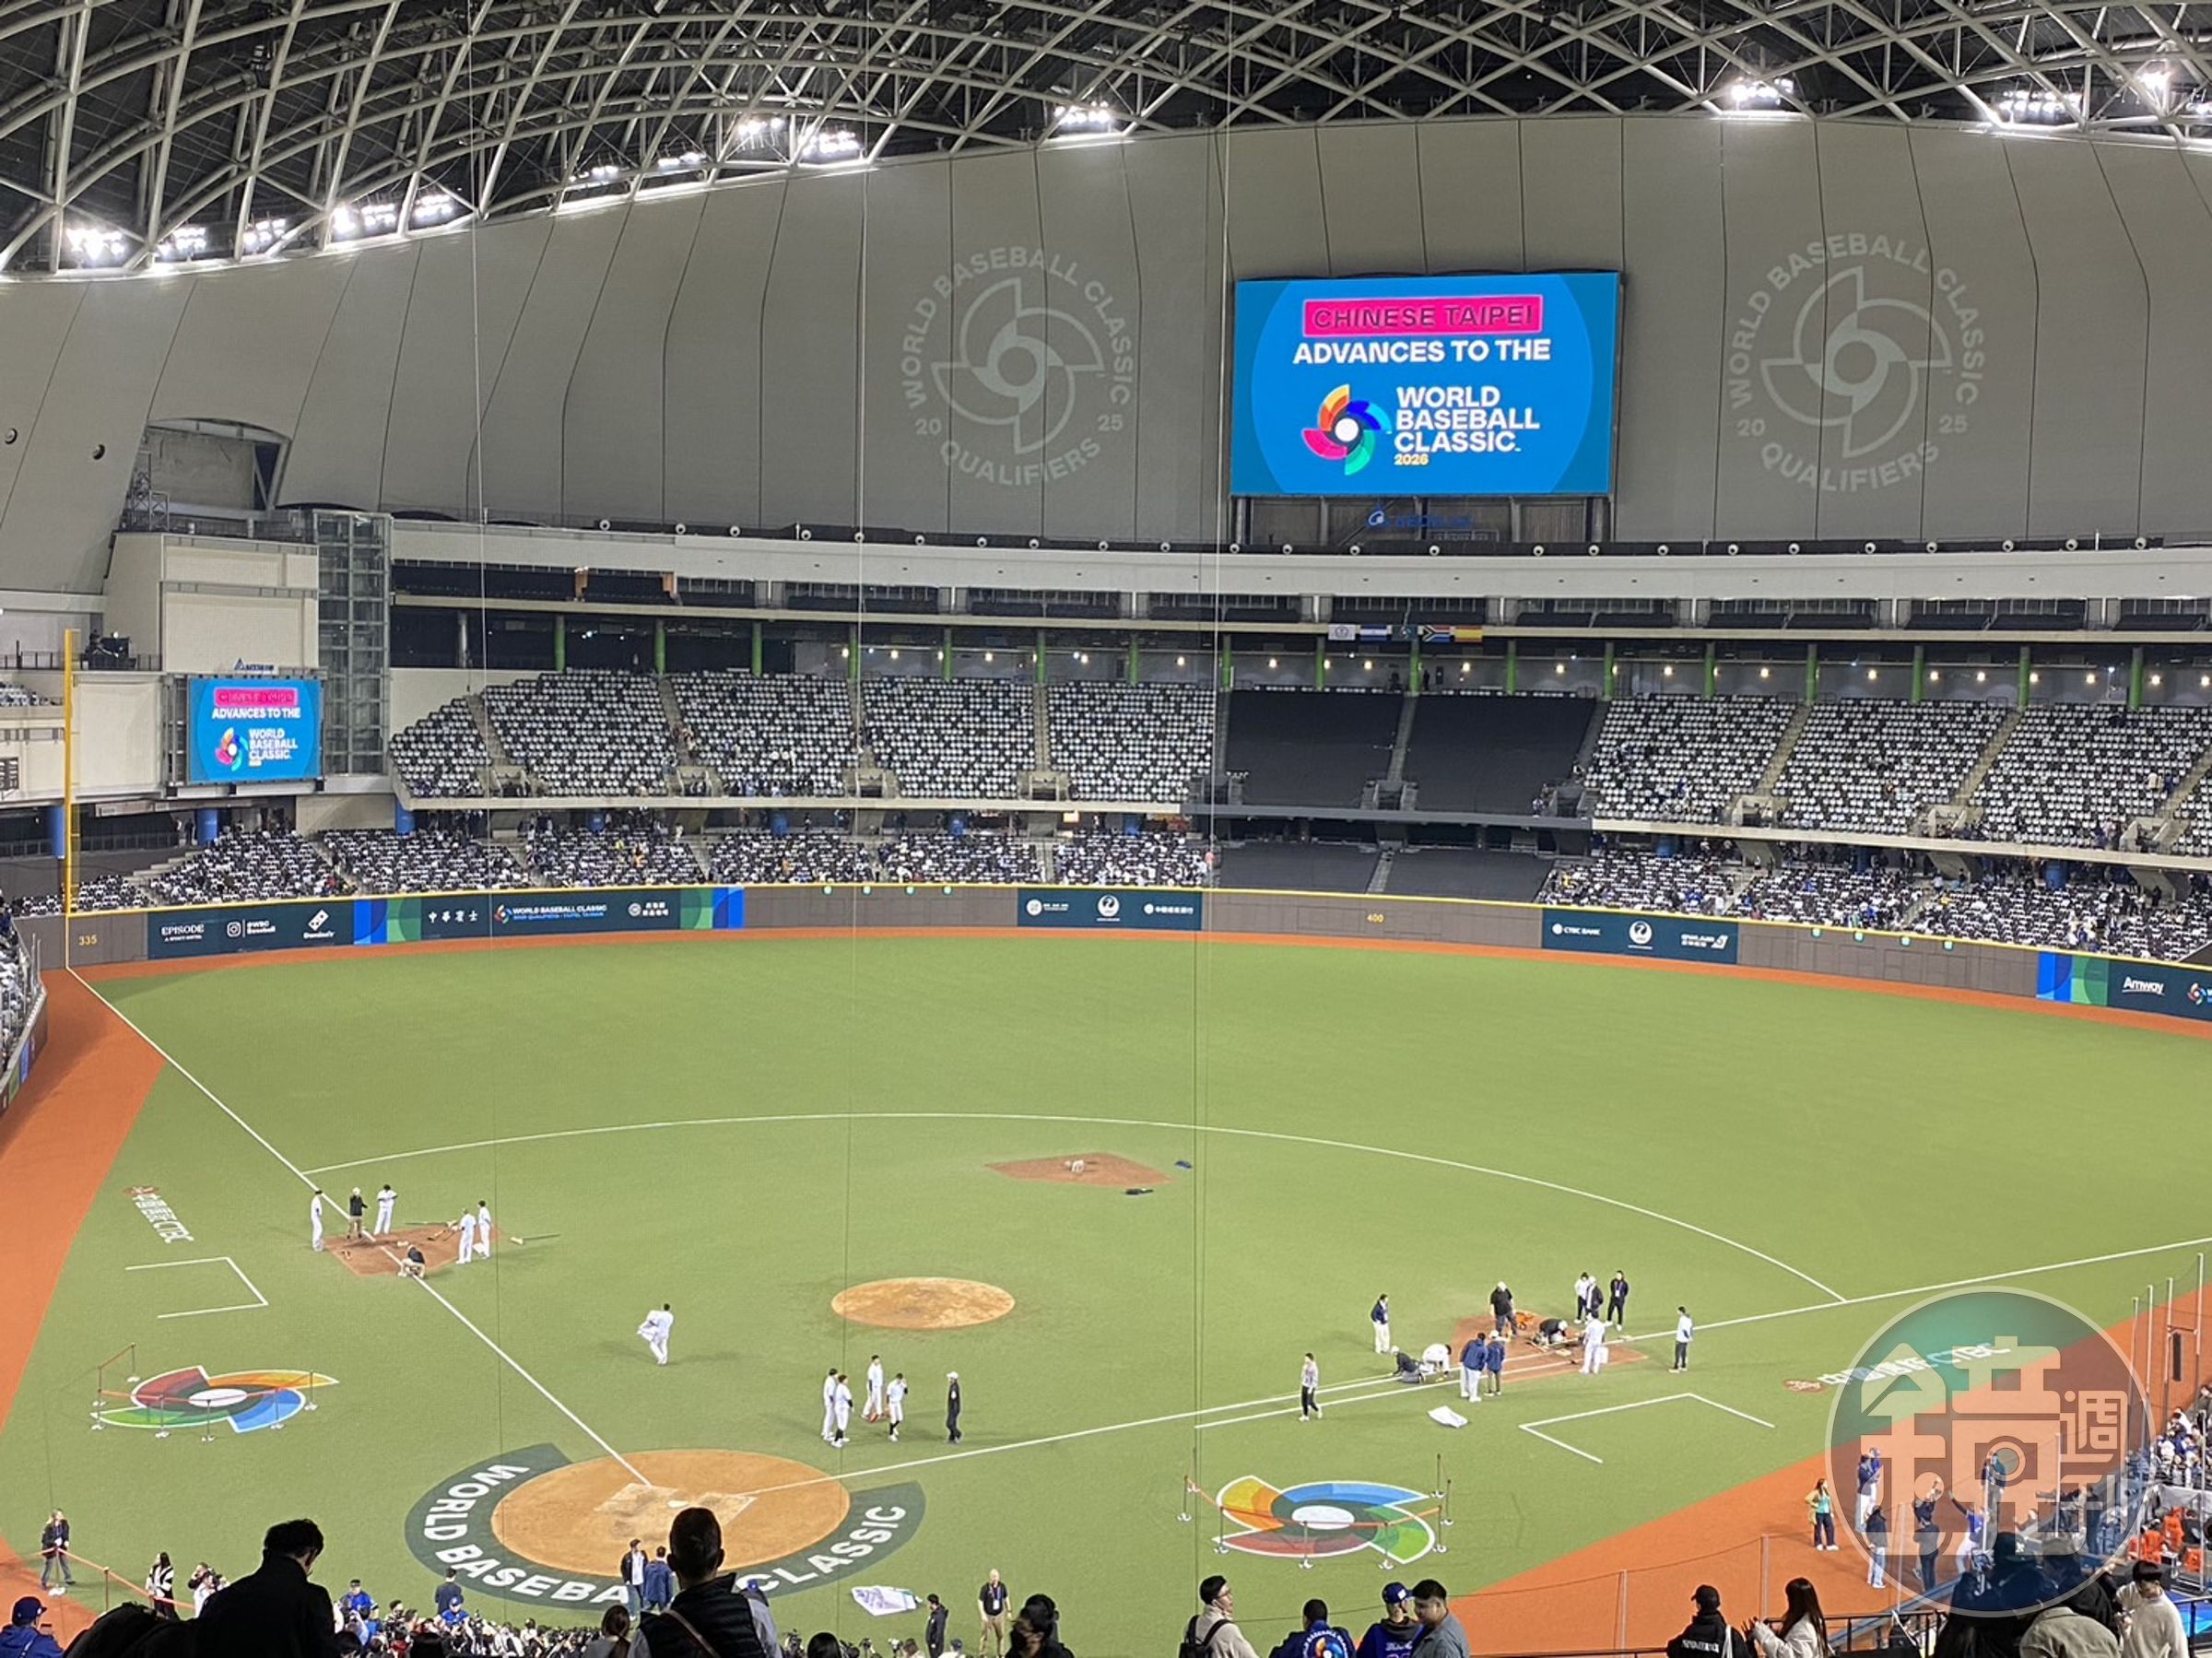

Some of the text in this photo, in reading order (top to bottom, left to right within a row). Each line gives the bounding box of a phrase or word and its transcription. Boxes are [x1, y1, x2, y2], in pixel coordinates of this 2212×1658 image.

[900, 246, 1134, 408] WORLD BASEBALL CLASSIC
[1314, 305, 1534, 330] CHINESE TAIPEI
[1728, 233, 1984, 409] WORLD BASEBALL CLASSIC
[1292, 338, 1551, 365] ADVANCES TO THE
[1396, 385, 1500, 408] WORLD
[915, 417, 942, 436] 20
[1097, 414, 1124, 433] 25
[1396, 407, 1540, 430] BASEBALL
[1736, 417, 1766, 437] 20
[1938, 414, 1968, 434] 25
[940, 437, 1100, 486] QUALIFIERS
[1394, 453, 1430, 466] 2026
[1760, 440, 1939, 492] QUALIFIERS
[212, 708, 300, 719] ADVANCES TO THE
[249, 728, 285, 739] WORLD
[249, 738, 298, 749] BASEBALL
[576, 904, 608, 912] CLASSIC
[161, 923, 205, 935] EPISODE
[78, 934, 98, 947] 335
[2124, 976, 2164, 994] Amway
[423, 1464, 907, 1605] WORLD BASEBA CLASSIC
